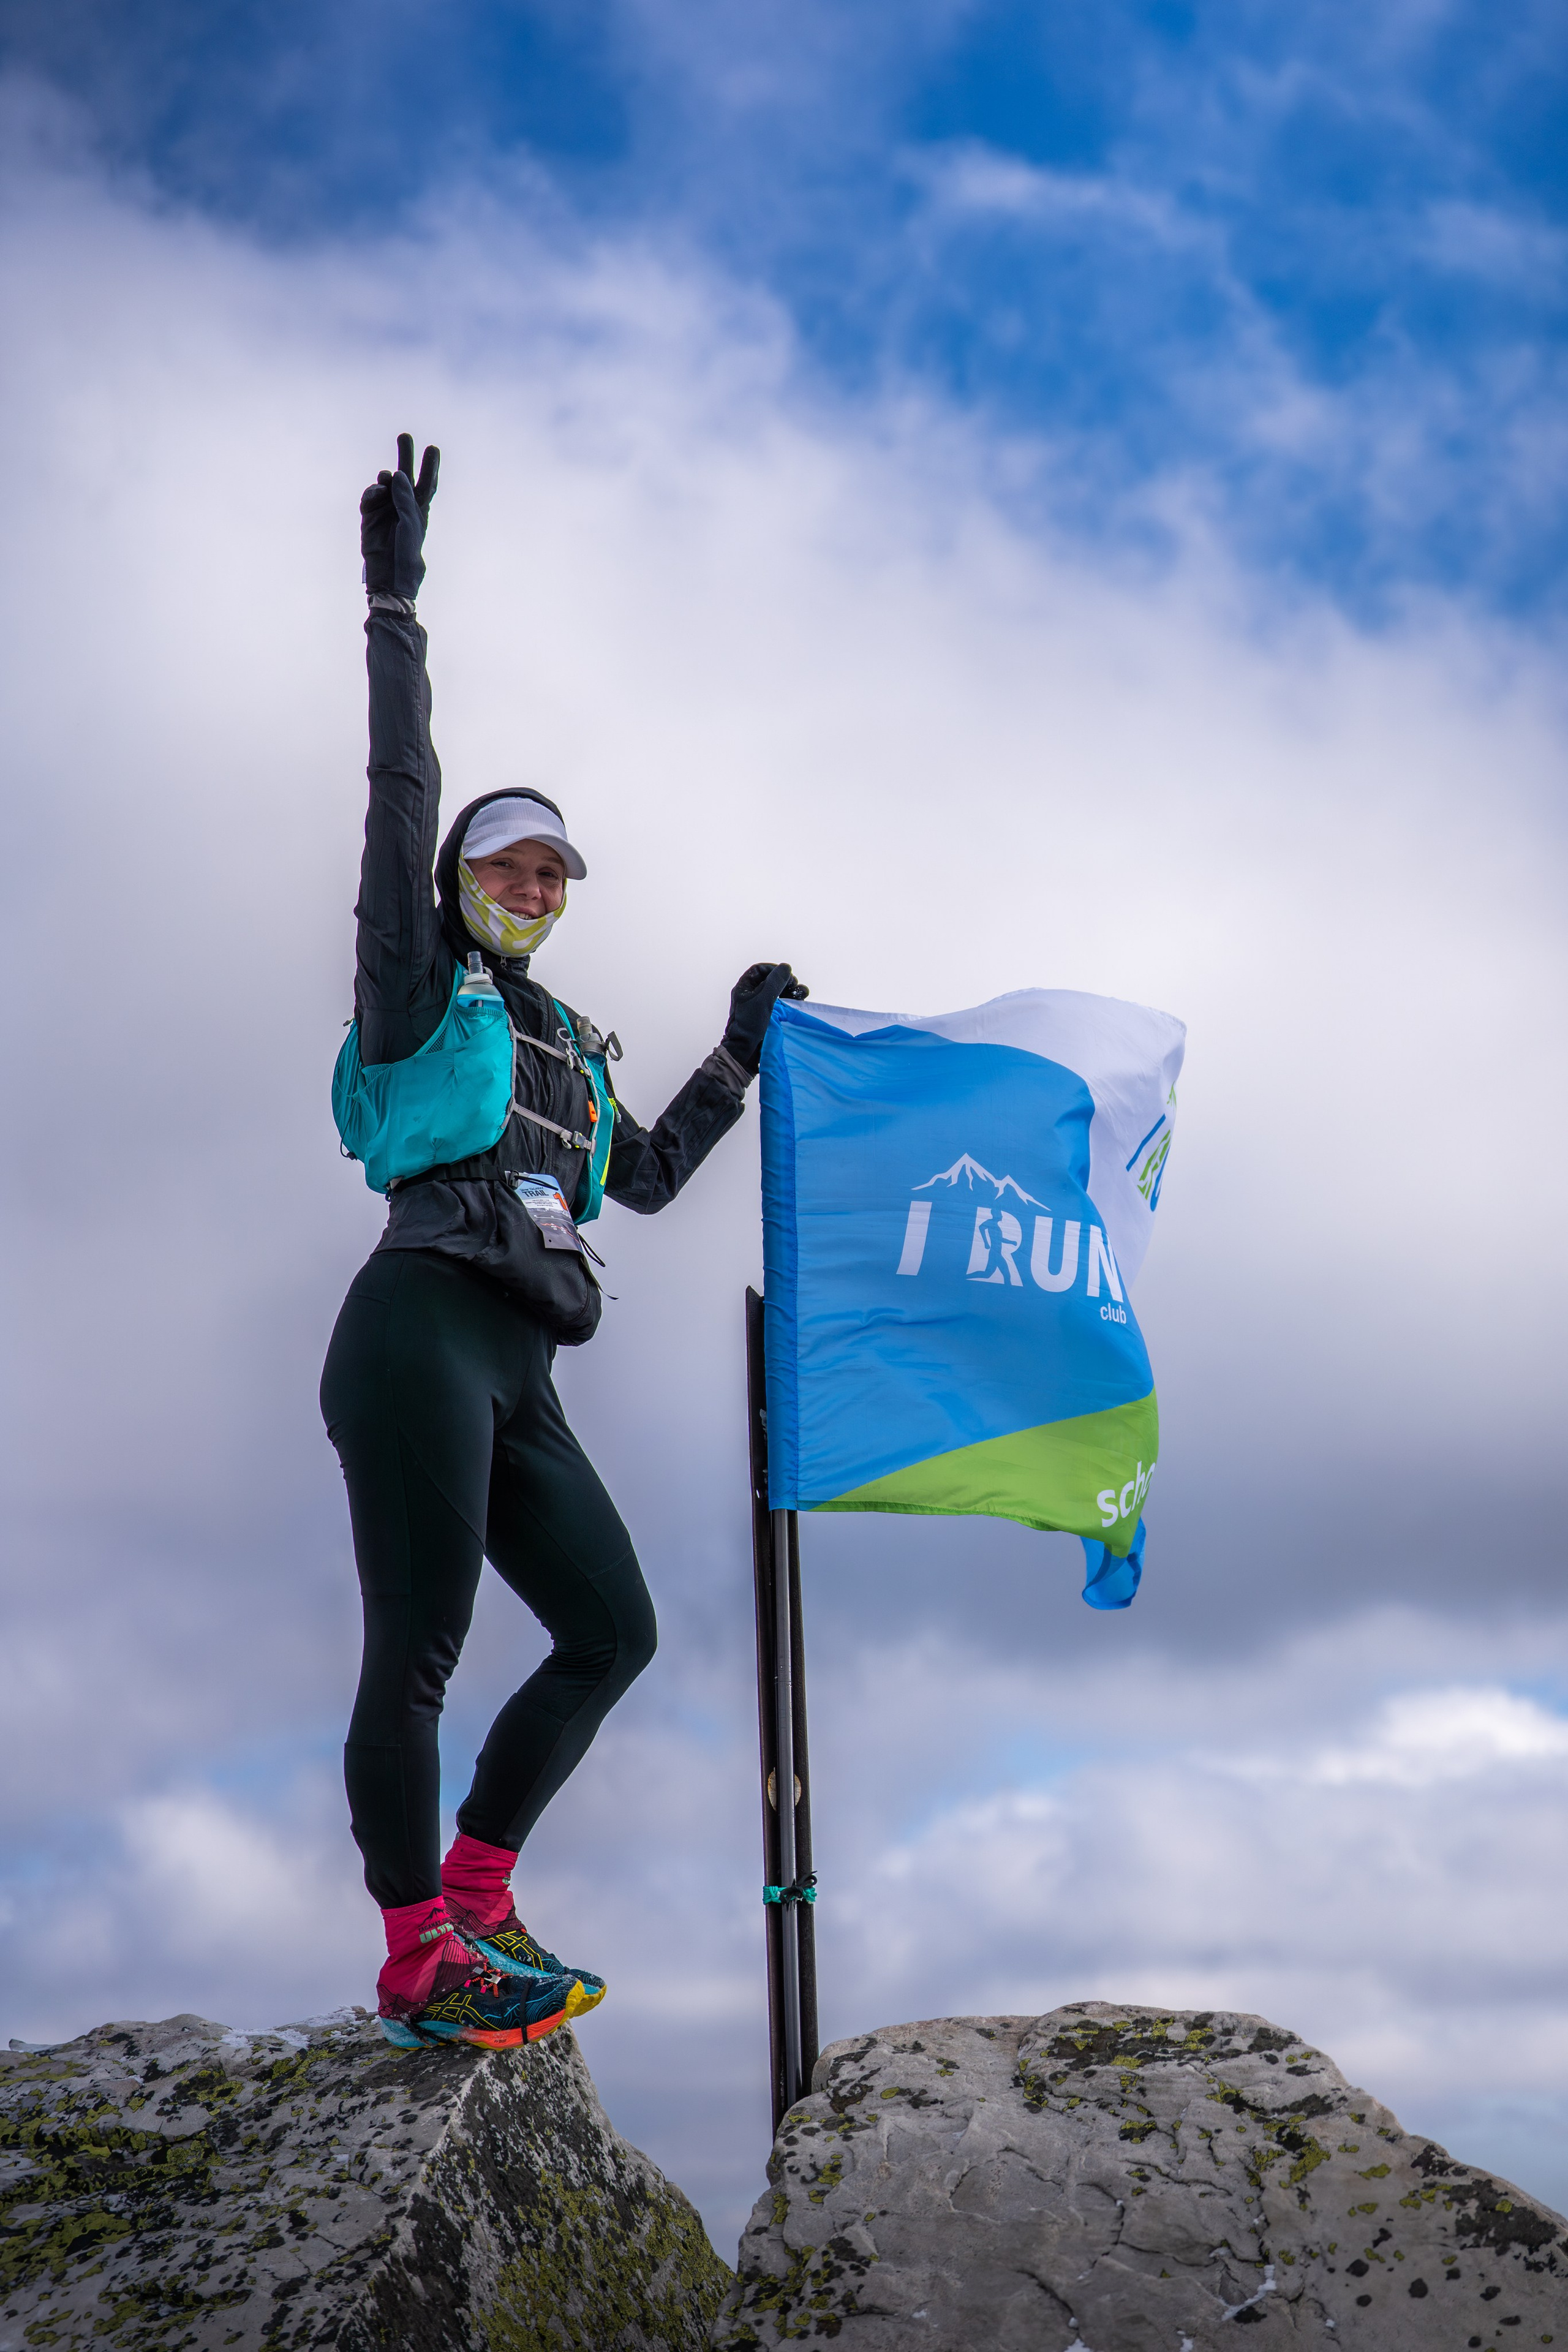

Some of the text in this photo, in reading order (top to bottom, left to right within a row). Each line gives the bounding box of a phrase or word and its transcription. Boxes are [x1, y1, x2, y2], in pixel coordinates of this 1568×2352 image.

[552, 1191, 568, 1212] 1
[896, 1201, 1123, 1303] I RUN
[1100, 1302, 1127, 1324] club
[1096, 1461, 1156, 1528] scho
[419, 1923, 454, 1943] ULTR
